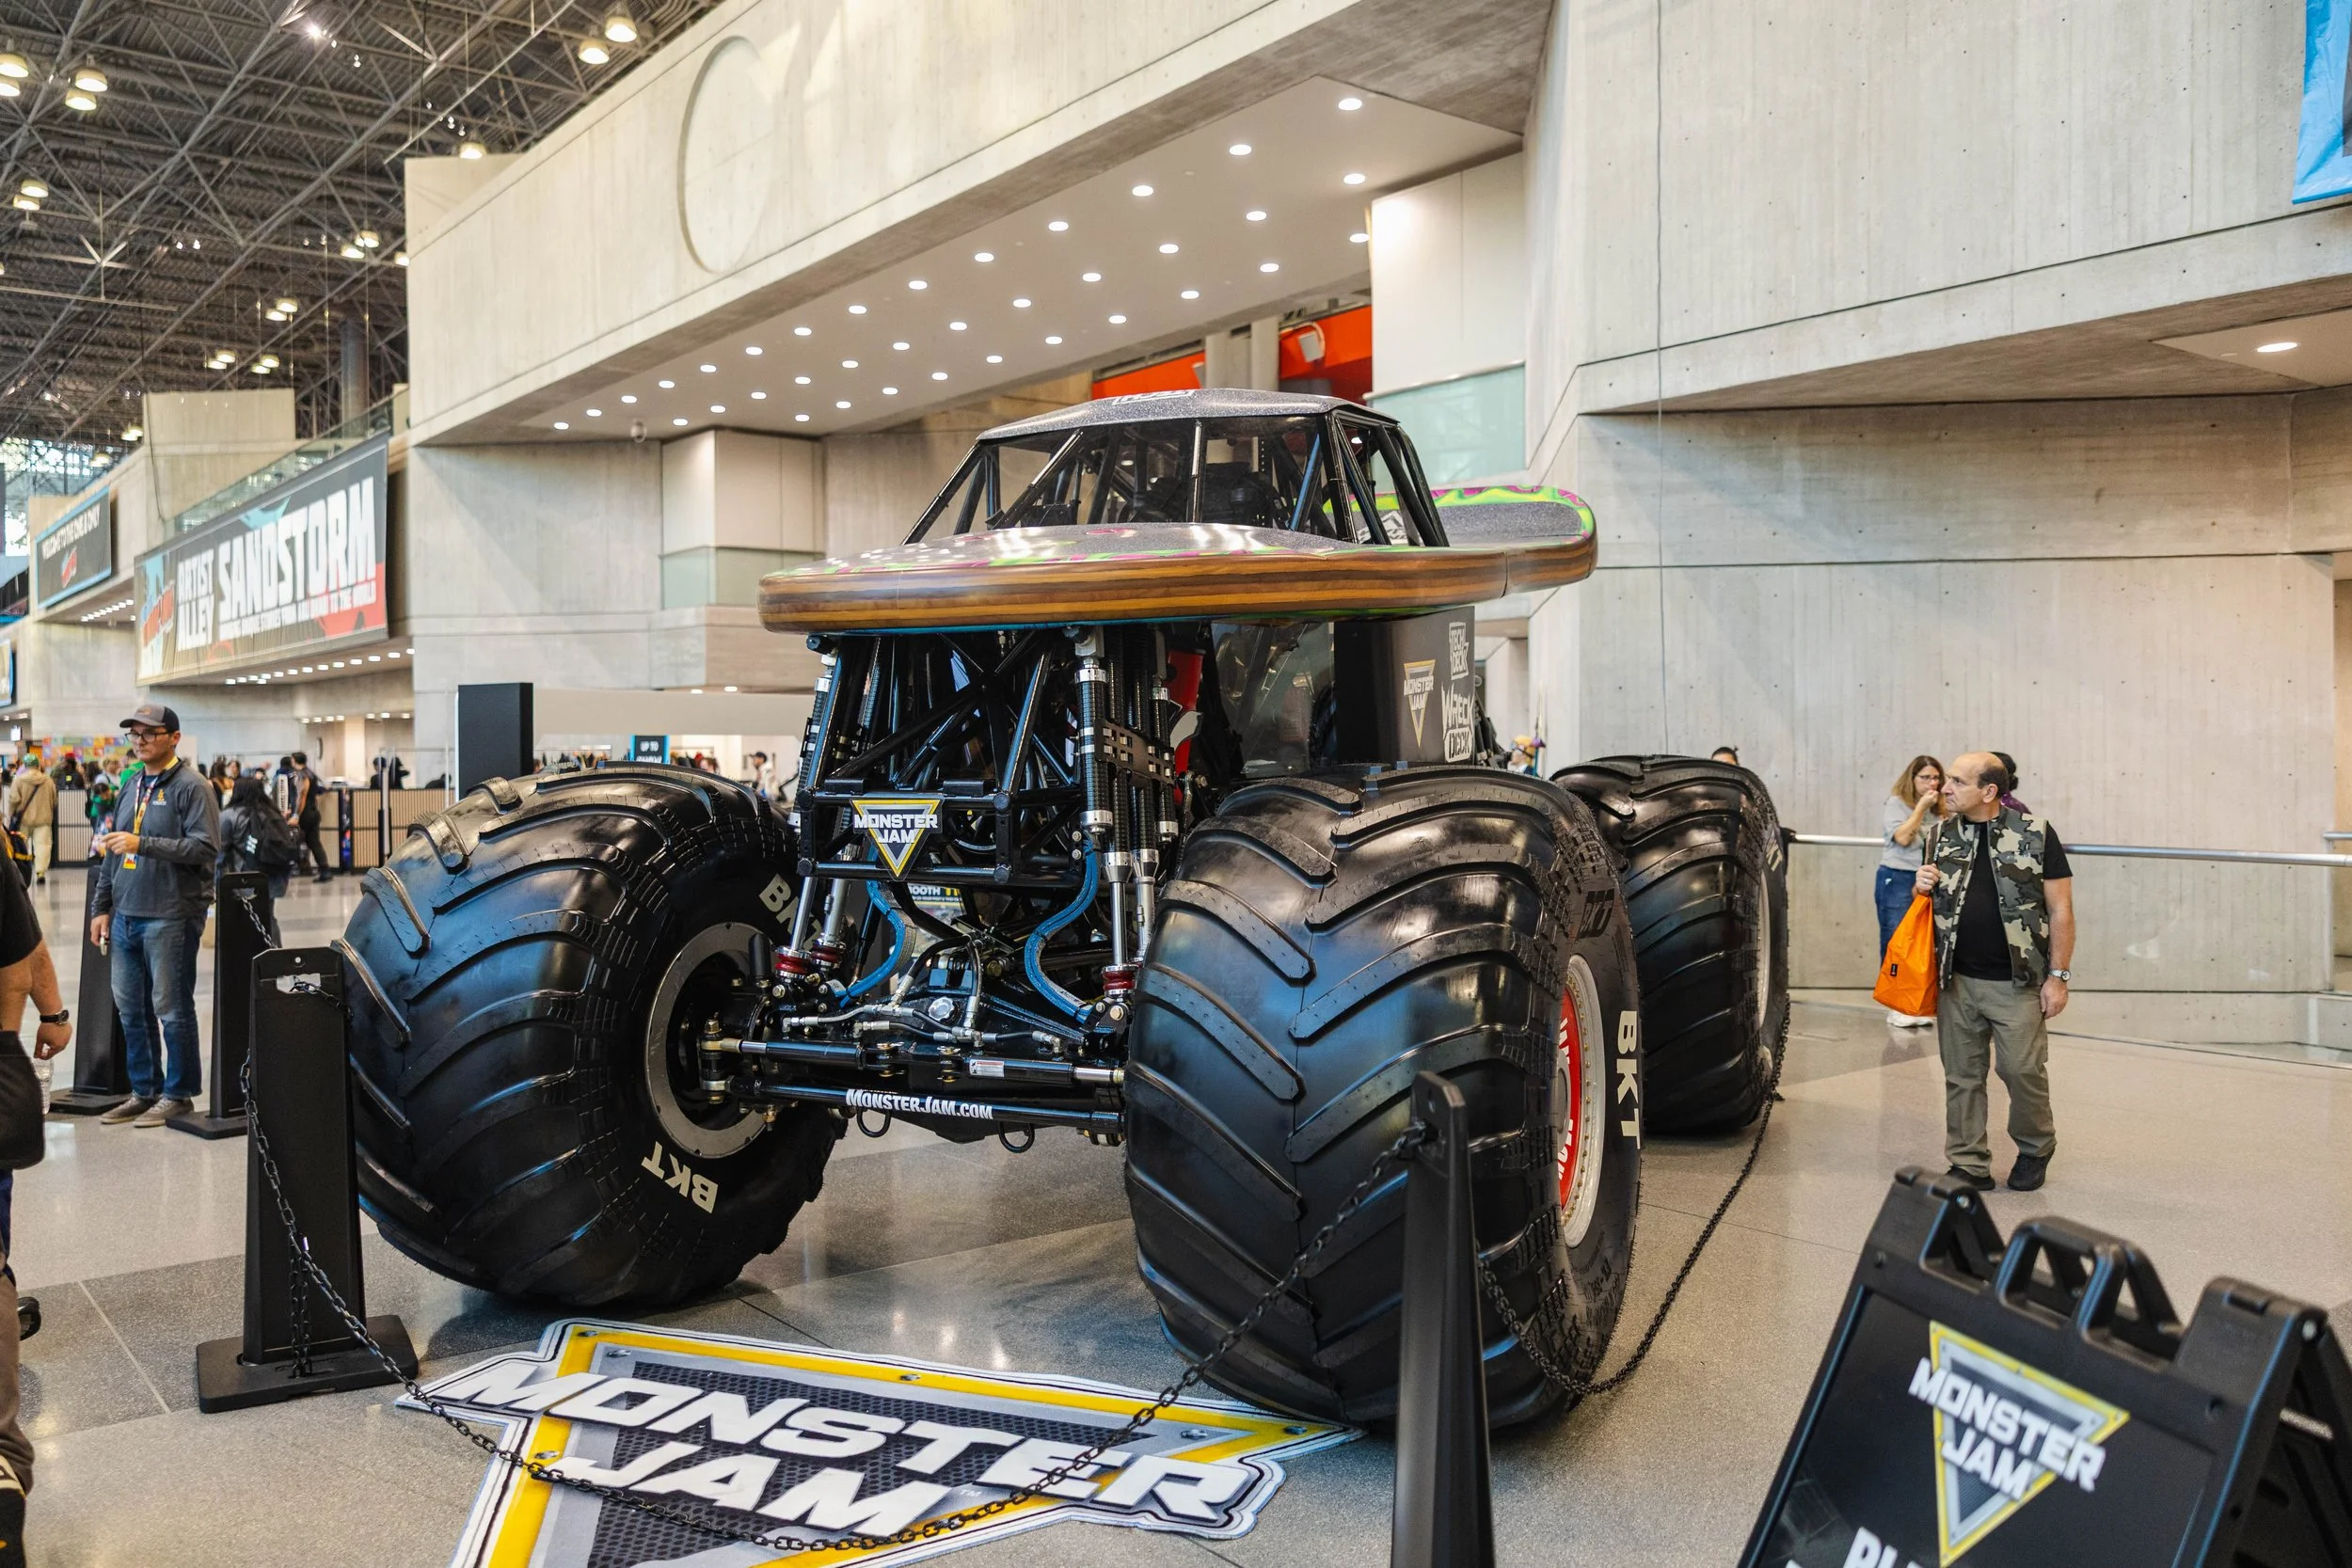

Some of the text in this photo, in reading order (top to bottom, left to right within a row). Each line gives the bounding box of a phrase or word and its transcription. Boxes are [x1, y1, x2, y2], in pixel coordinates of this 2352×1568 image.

[178, 548, 215, 605] ARTIST
[218, 476, 376, 625] SANDSTORM
[177, 594, 215, 652] ALLEY
[1403, 675, 1435, 696] MONSTER
[1411, 694, 1426, 711] JAM
[1441, 682, 1474, 741] WRECK
[1448, 731, 1470, 759] DECK
[853, 814, 939, 829] MONSTER
[877, 829, 915, 844] JAM
[909, 885, 941, 896] OOTH
[1616, 1010, 1641, 1149] BKT
[641, 1141, 719, 1213] BKT
[440, 1363, 1251, 1522] MONSTER
[1908, 1356, 2106, 1493] MONSTER
[543, 1441, 953, 1537] JAM
[1941, 1428, 2034, 1500] JAM
